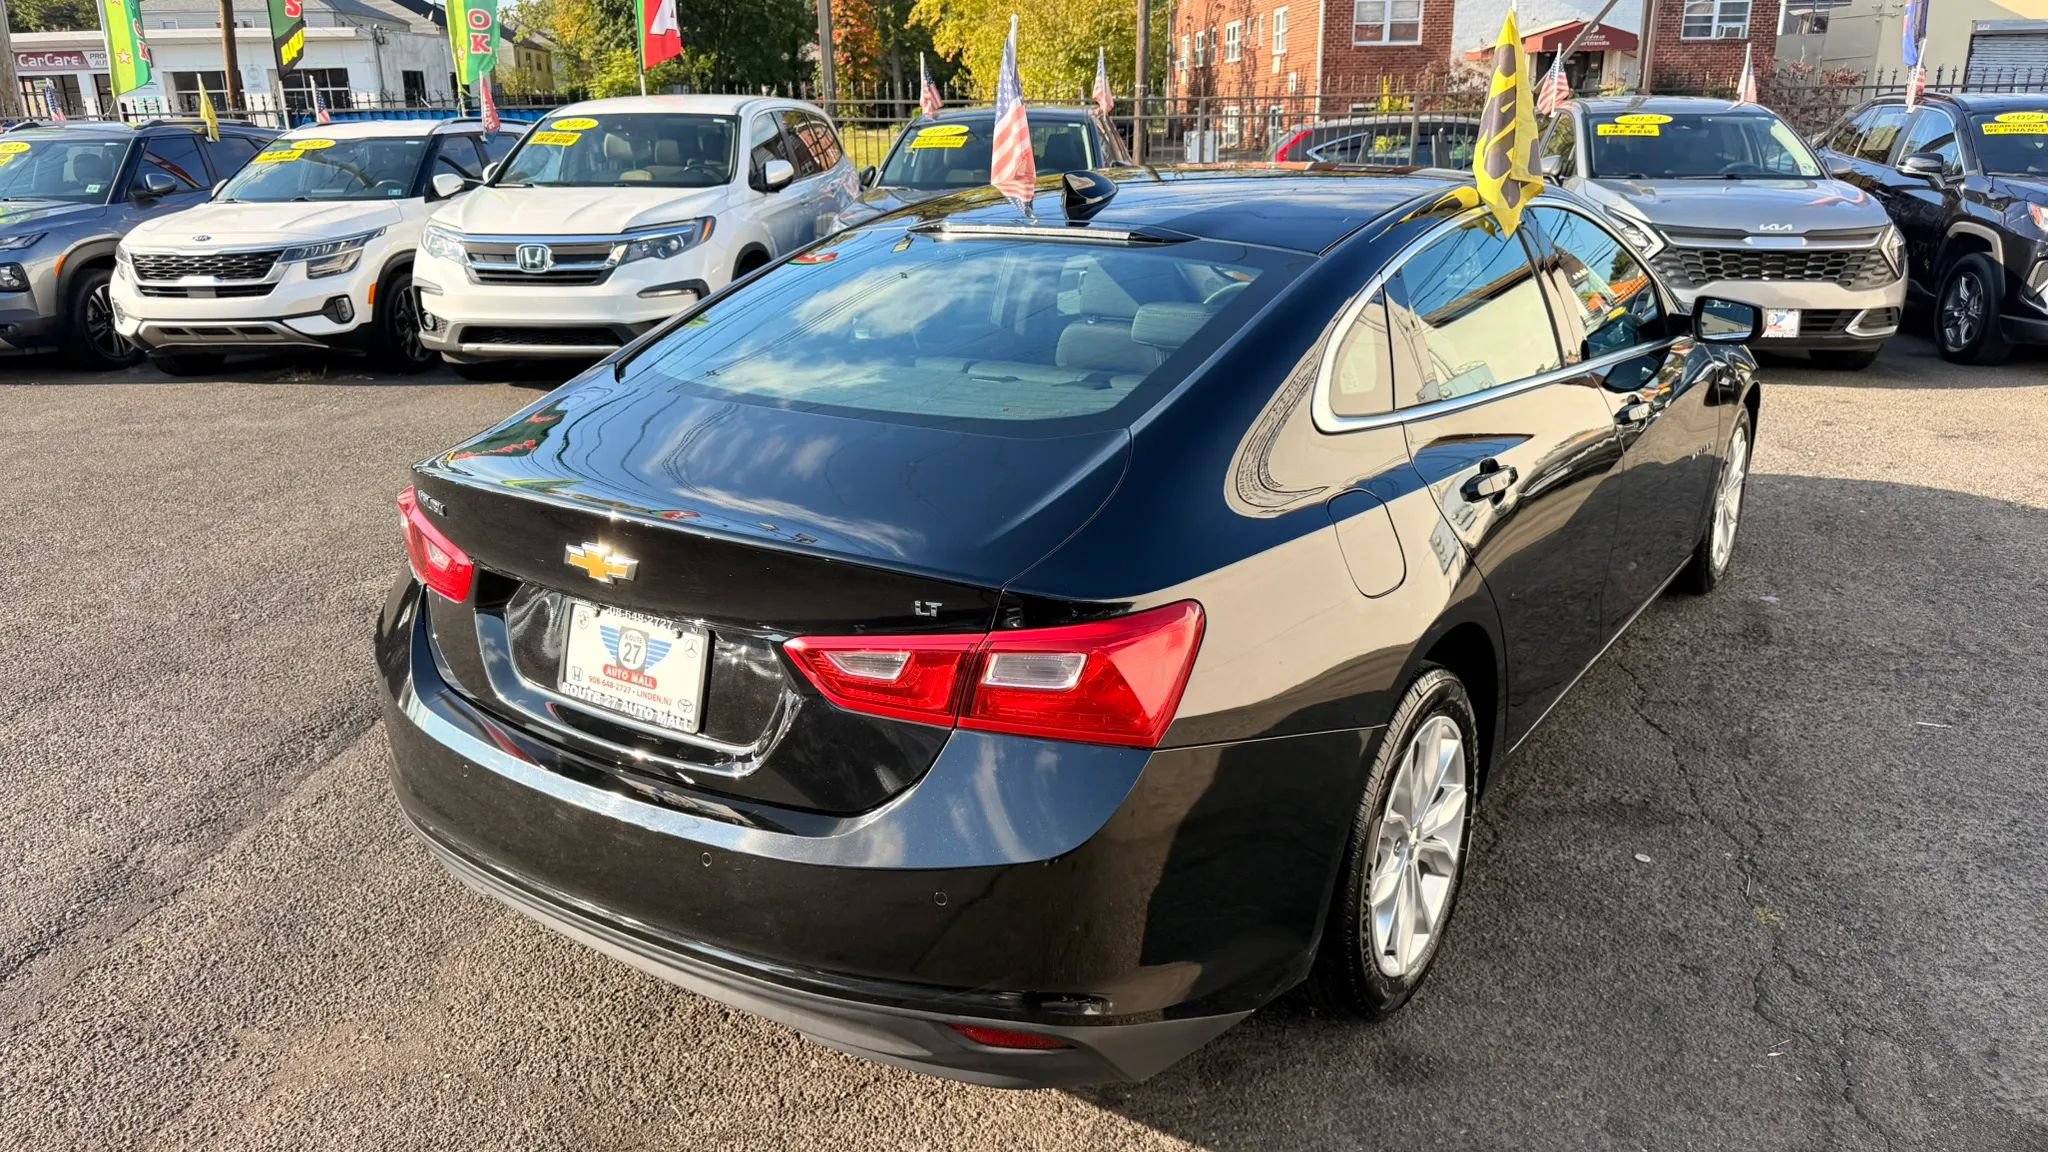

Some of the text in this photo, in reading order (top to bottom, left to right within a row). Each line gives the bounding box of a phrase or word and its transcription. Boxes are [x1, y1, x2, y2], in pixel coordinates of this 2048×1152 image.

[18, 53, 80, 67] CarCare
[914, 600, 943, 617] LT
[624, 633, 643, 644] ROUTE
[622, 642, 642, 664] 27
[606, 665, 656, 688] AUTO MALL
[621, 701, 654, 720] AUTO
